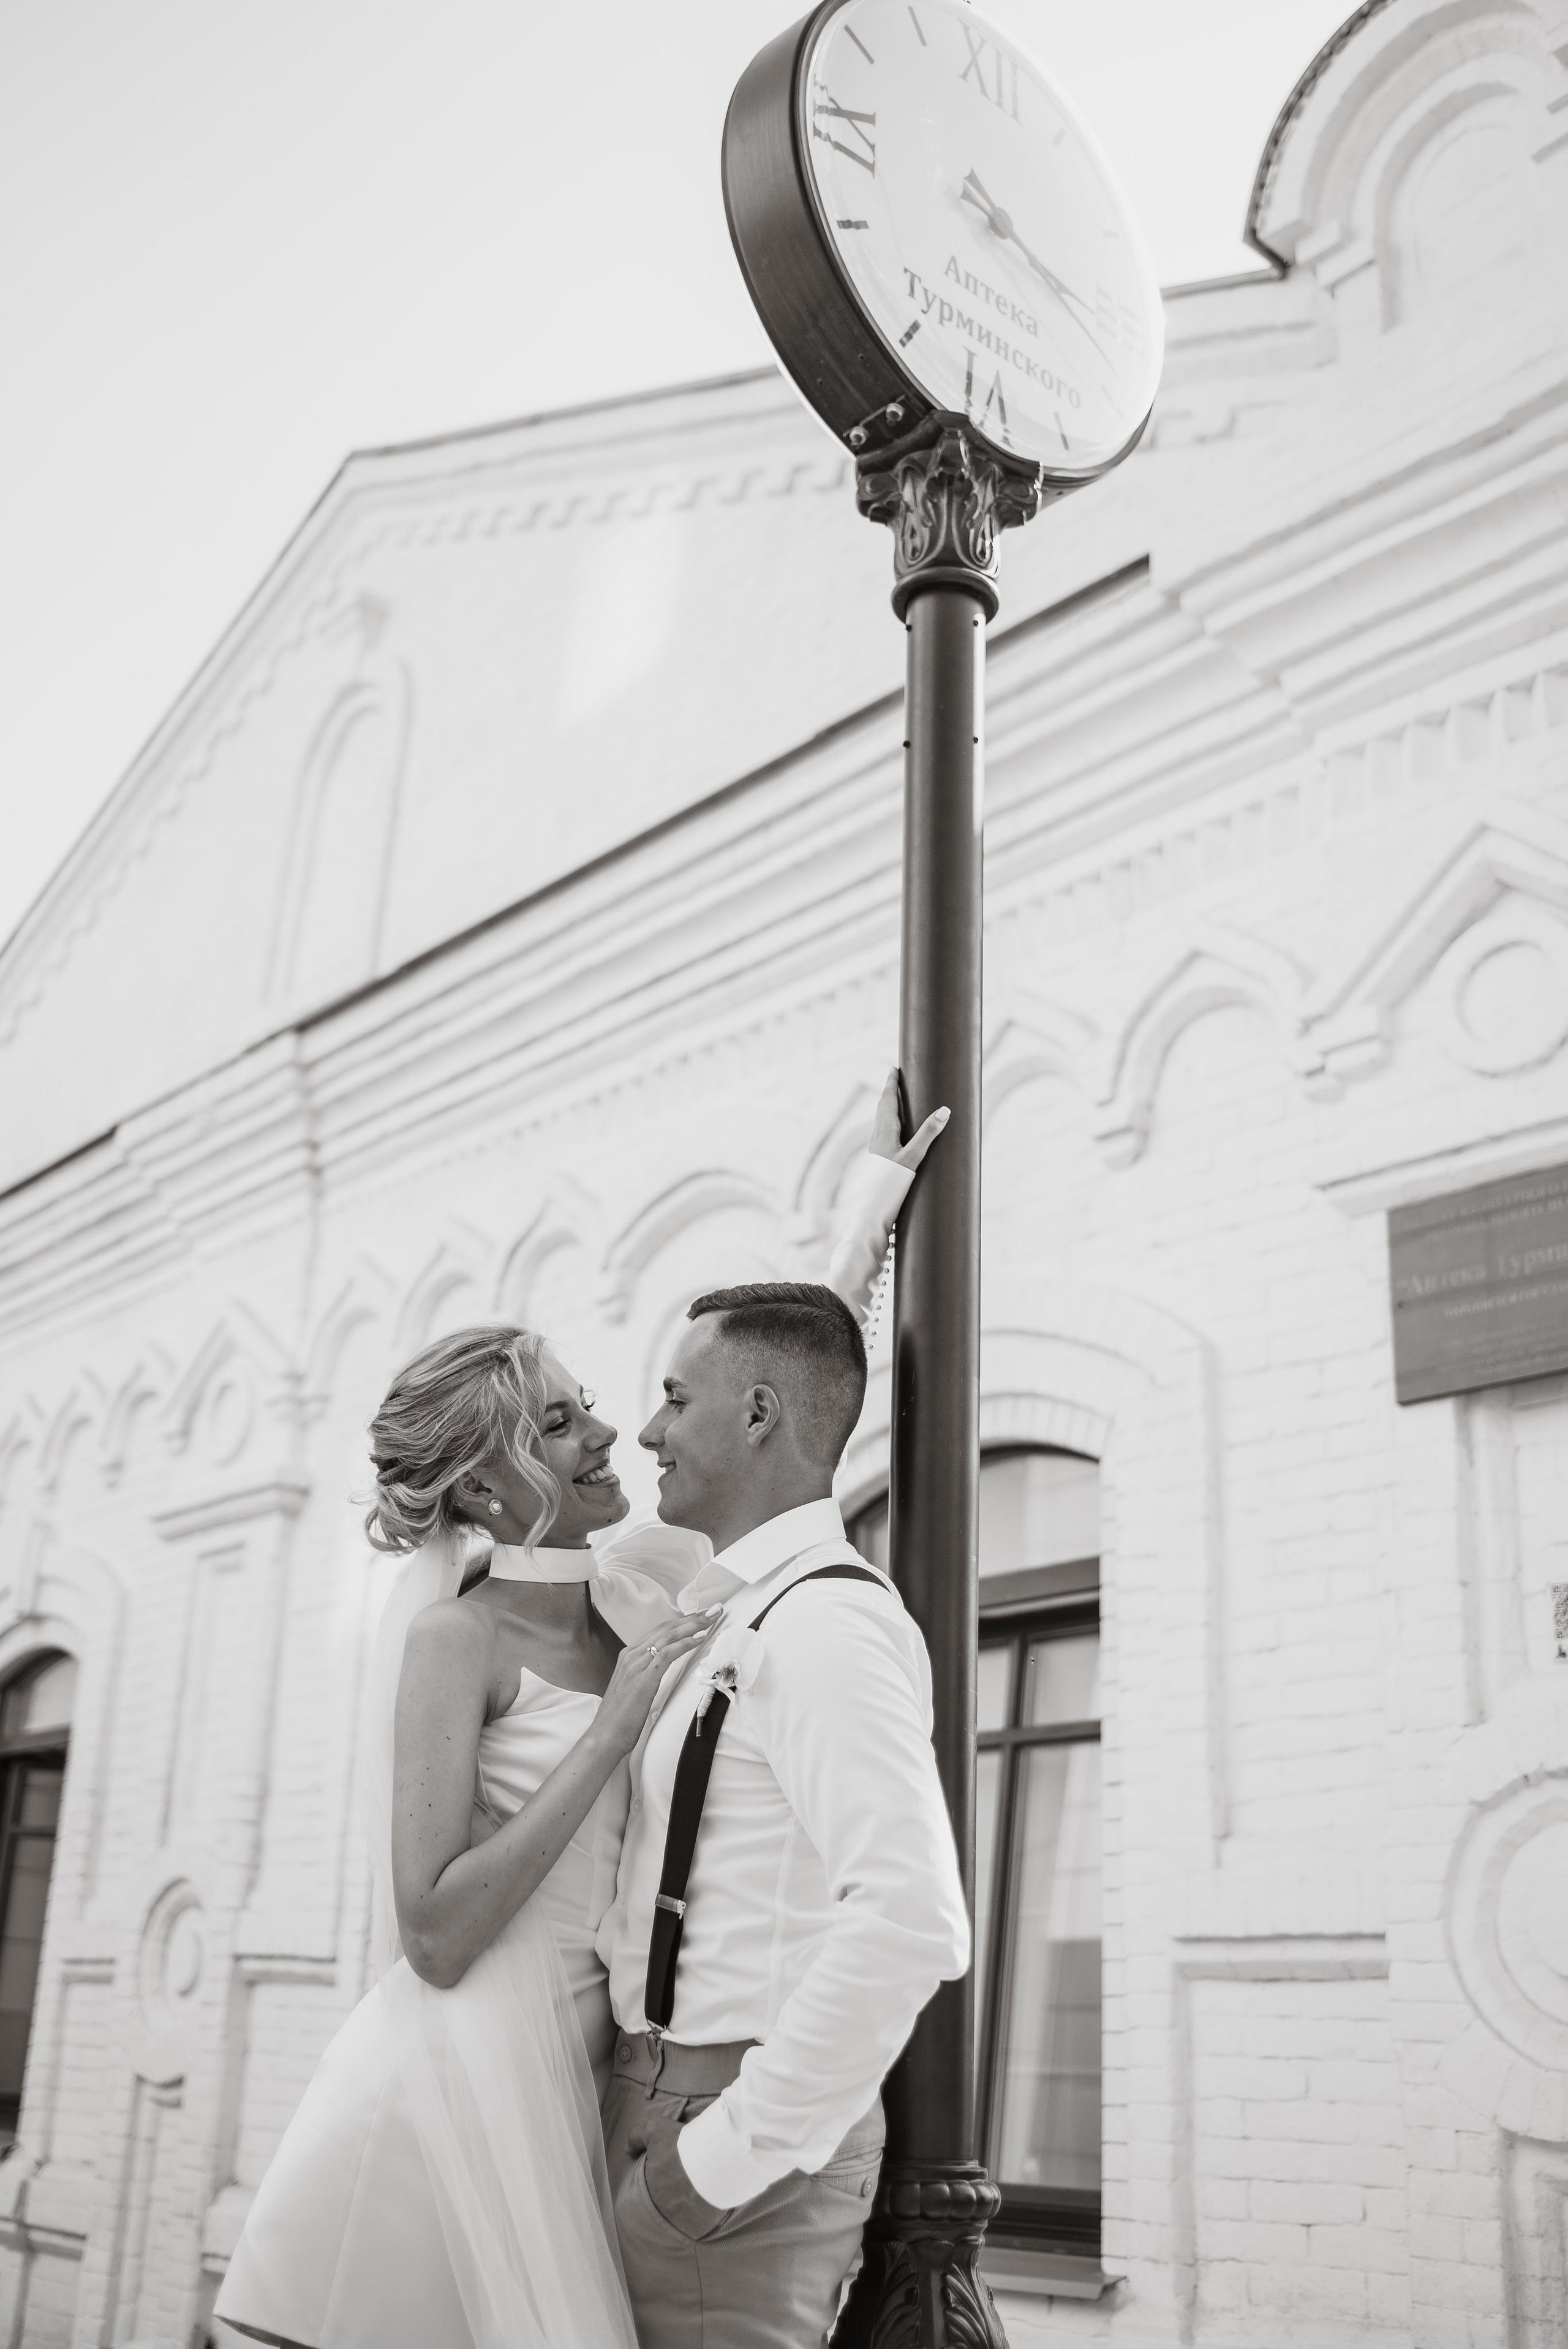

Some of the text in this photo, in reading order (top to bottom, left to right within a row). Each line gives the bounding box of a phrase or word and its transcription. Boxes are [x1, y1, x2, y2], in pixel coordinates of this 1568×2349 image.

[958, 18, 1024, 127] XII
[903, 267, 1080, 409] Турминского
[943, 255, 1038, 339] Аптека
